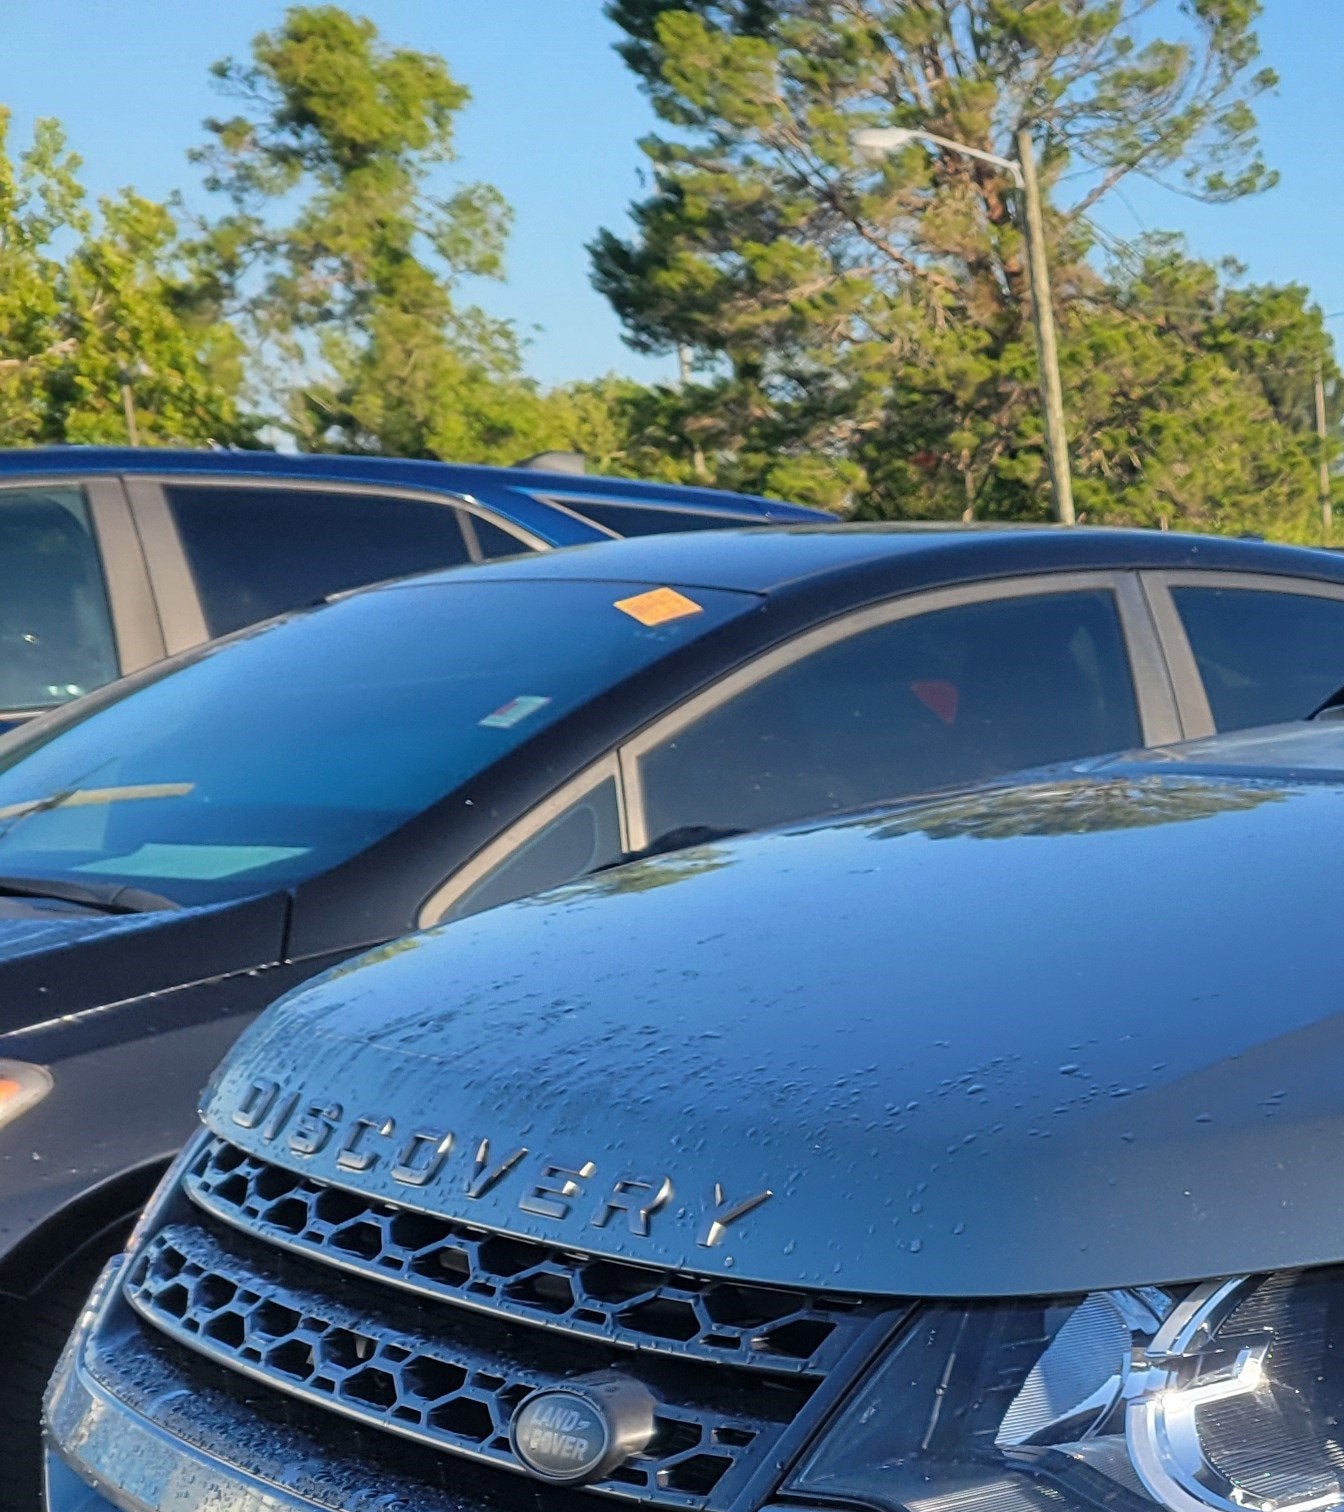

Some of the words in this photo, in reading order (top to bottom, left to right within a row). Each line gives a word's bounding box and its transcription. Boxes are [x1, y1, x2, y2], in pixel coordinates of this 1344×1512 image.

[231, 1079, 775, 1249] DISCOVERY
[532, 1406, 581, 1431] LAND
[529, 1427, 589, 1461] ROVER
